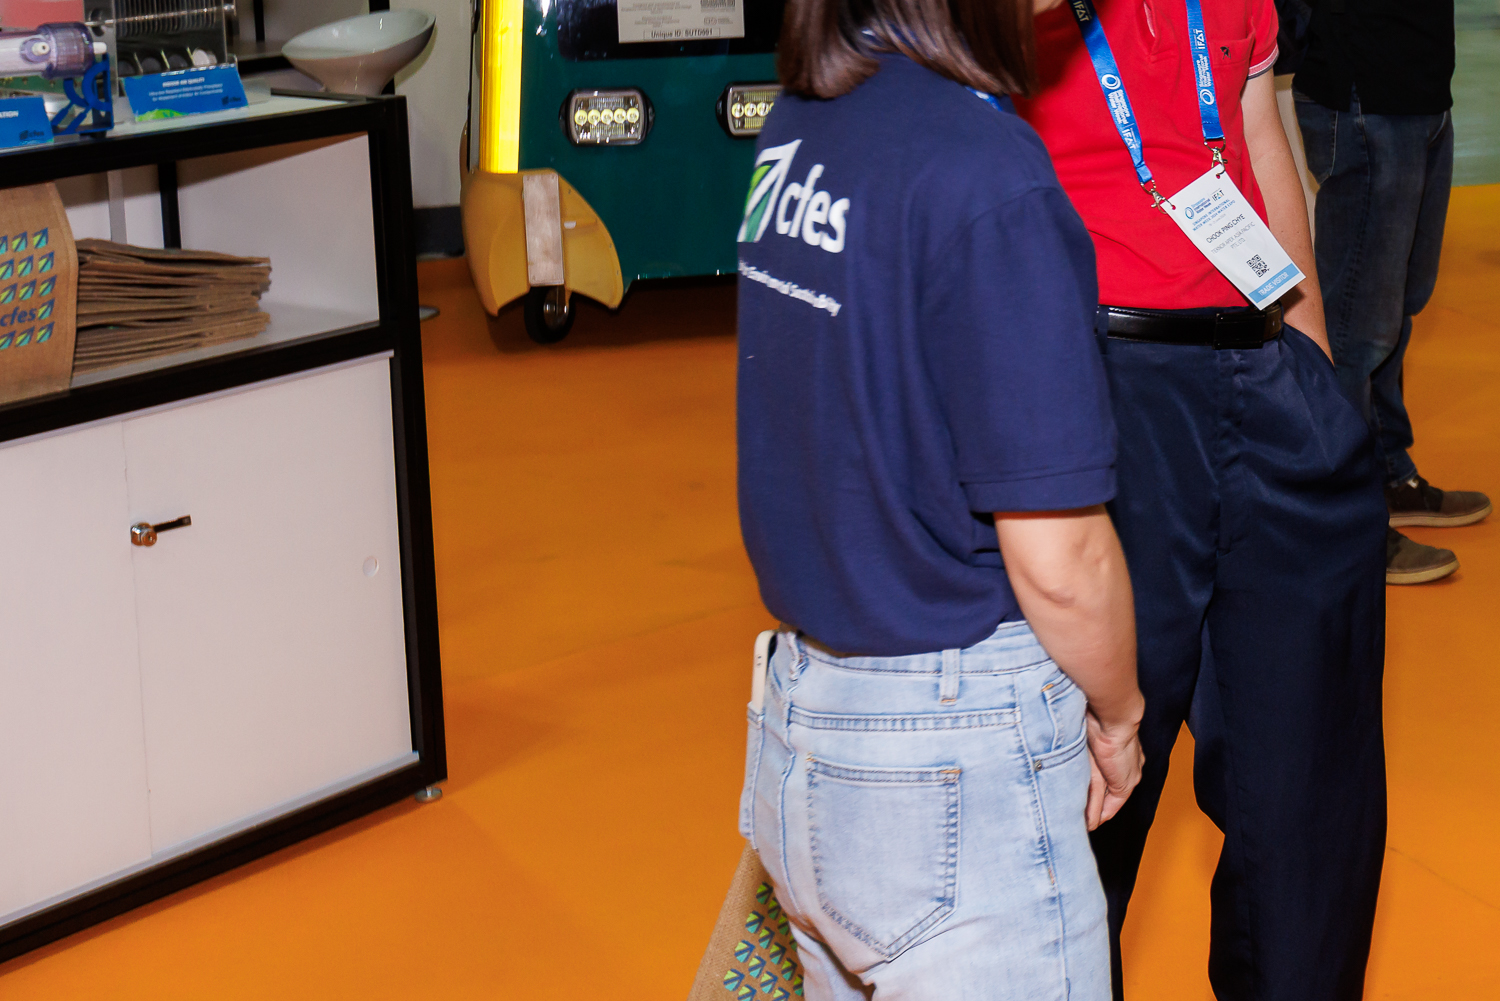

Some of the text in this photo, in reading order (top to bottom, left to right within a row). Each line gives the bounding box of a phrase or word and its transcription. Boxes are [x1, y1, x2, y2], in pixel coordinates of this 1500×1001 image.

[651, 29, 673, 40] Unique
[775, 163, 850, 253] cfes
[1258, 281, 1274, 296] TRADE
[0, 304, 36, 328] cfes
